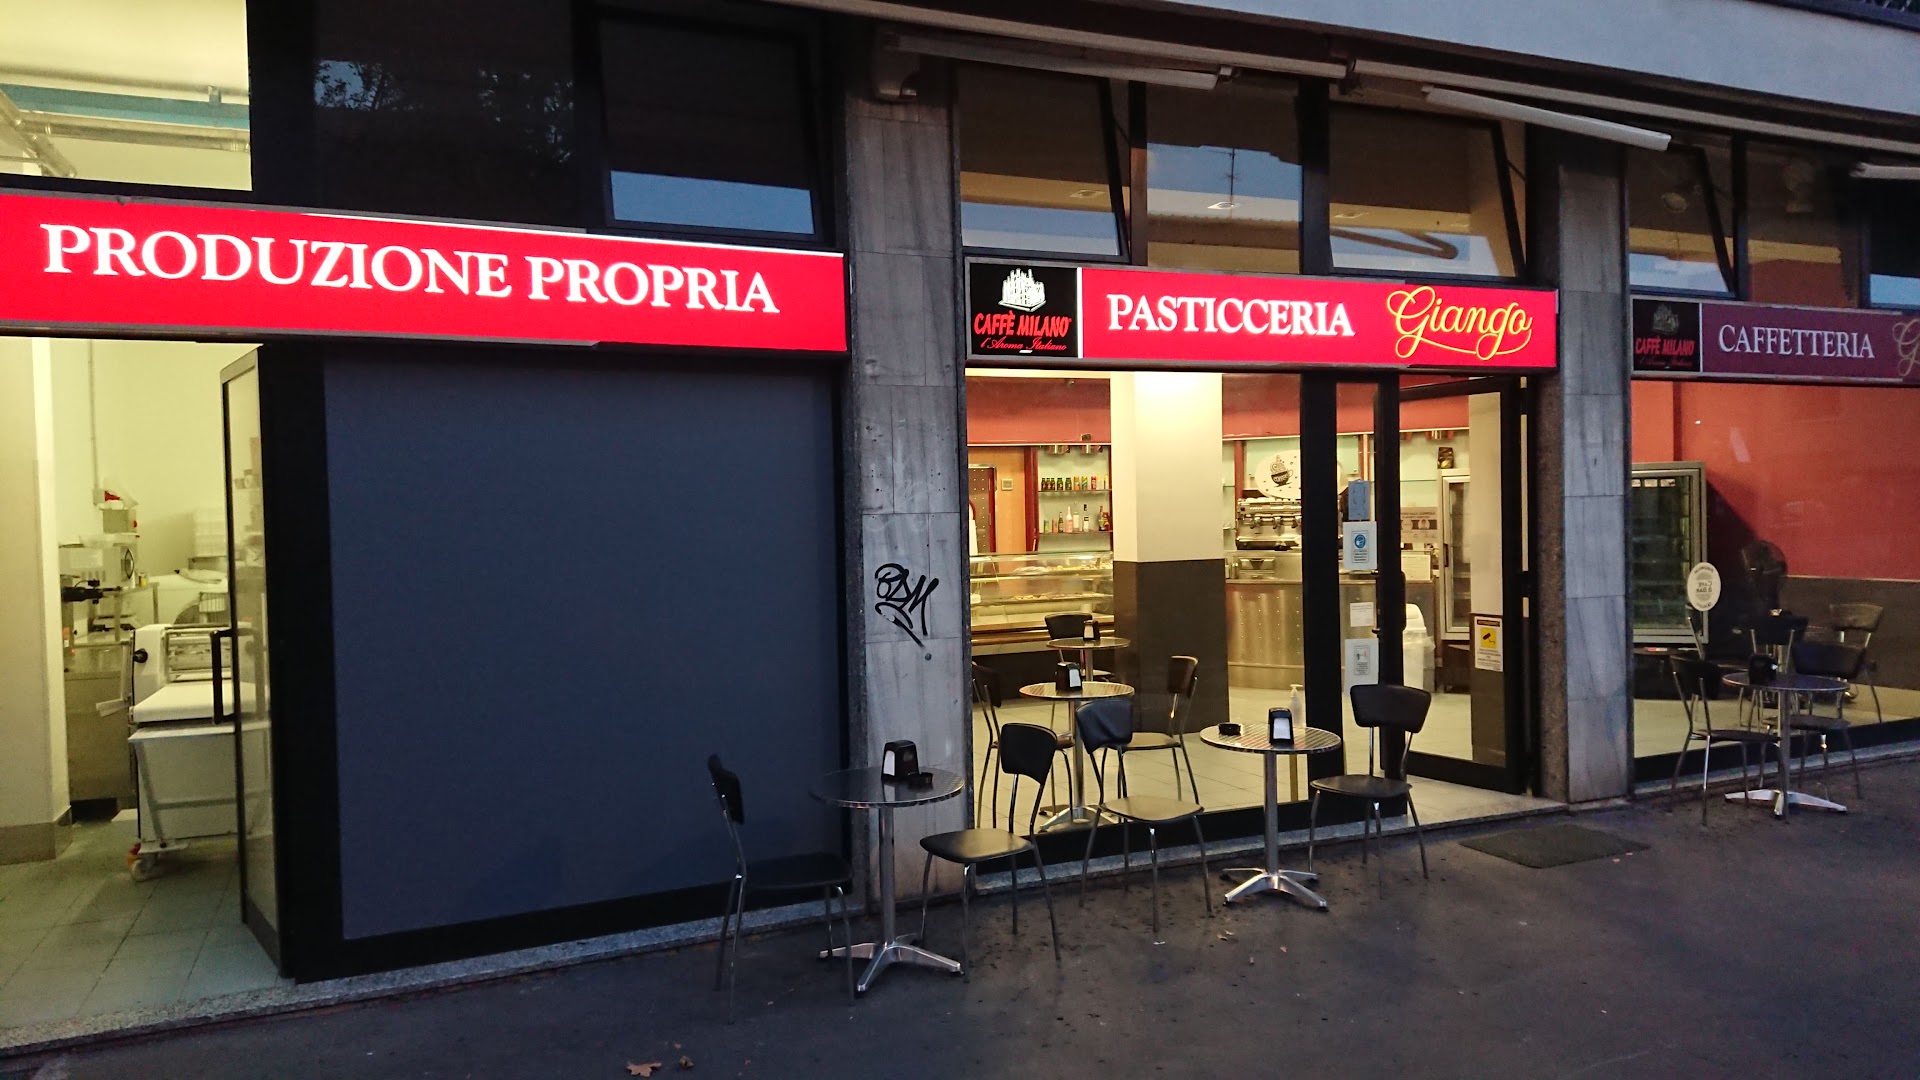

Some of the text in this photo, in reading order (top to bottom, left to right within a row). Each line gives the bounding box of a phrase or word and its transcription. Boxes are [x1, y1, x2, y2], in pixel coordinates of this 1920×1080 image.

[40, 222, 780, 314] PRODUZIONE PROPRIA
[974, 309, 1069, 338] CAFFÈ MILANO
[1106, 293, 1356, 337] PASTICCERIA
[1387, 286, 1533, 361] Giango
[1025, 337, 1067, 350] Italiano
[1718, 324, 1876, 359] CAFFETTERIA
